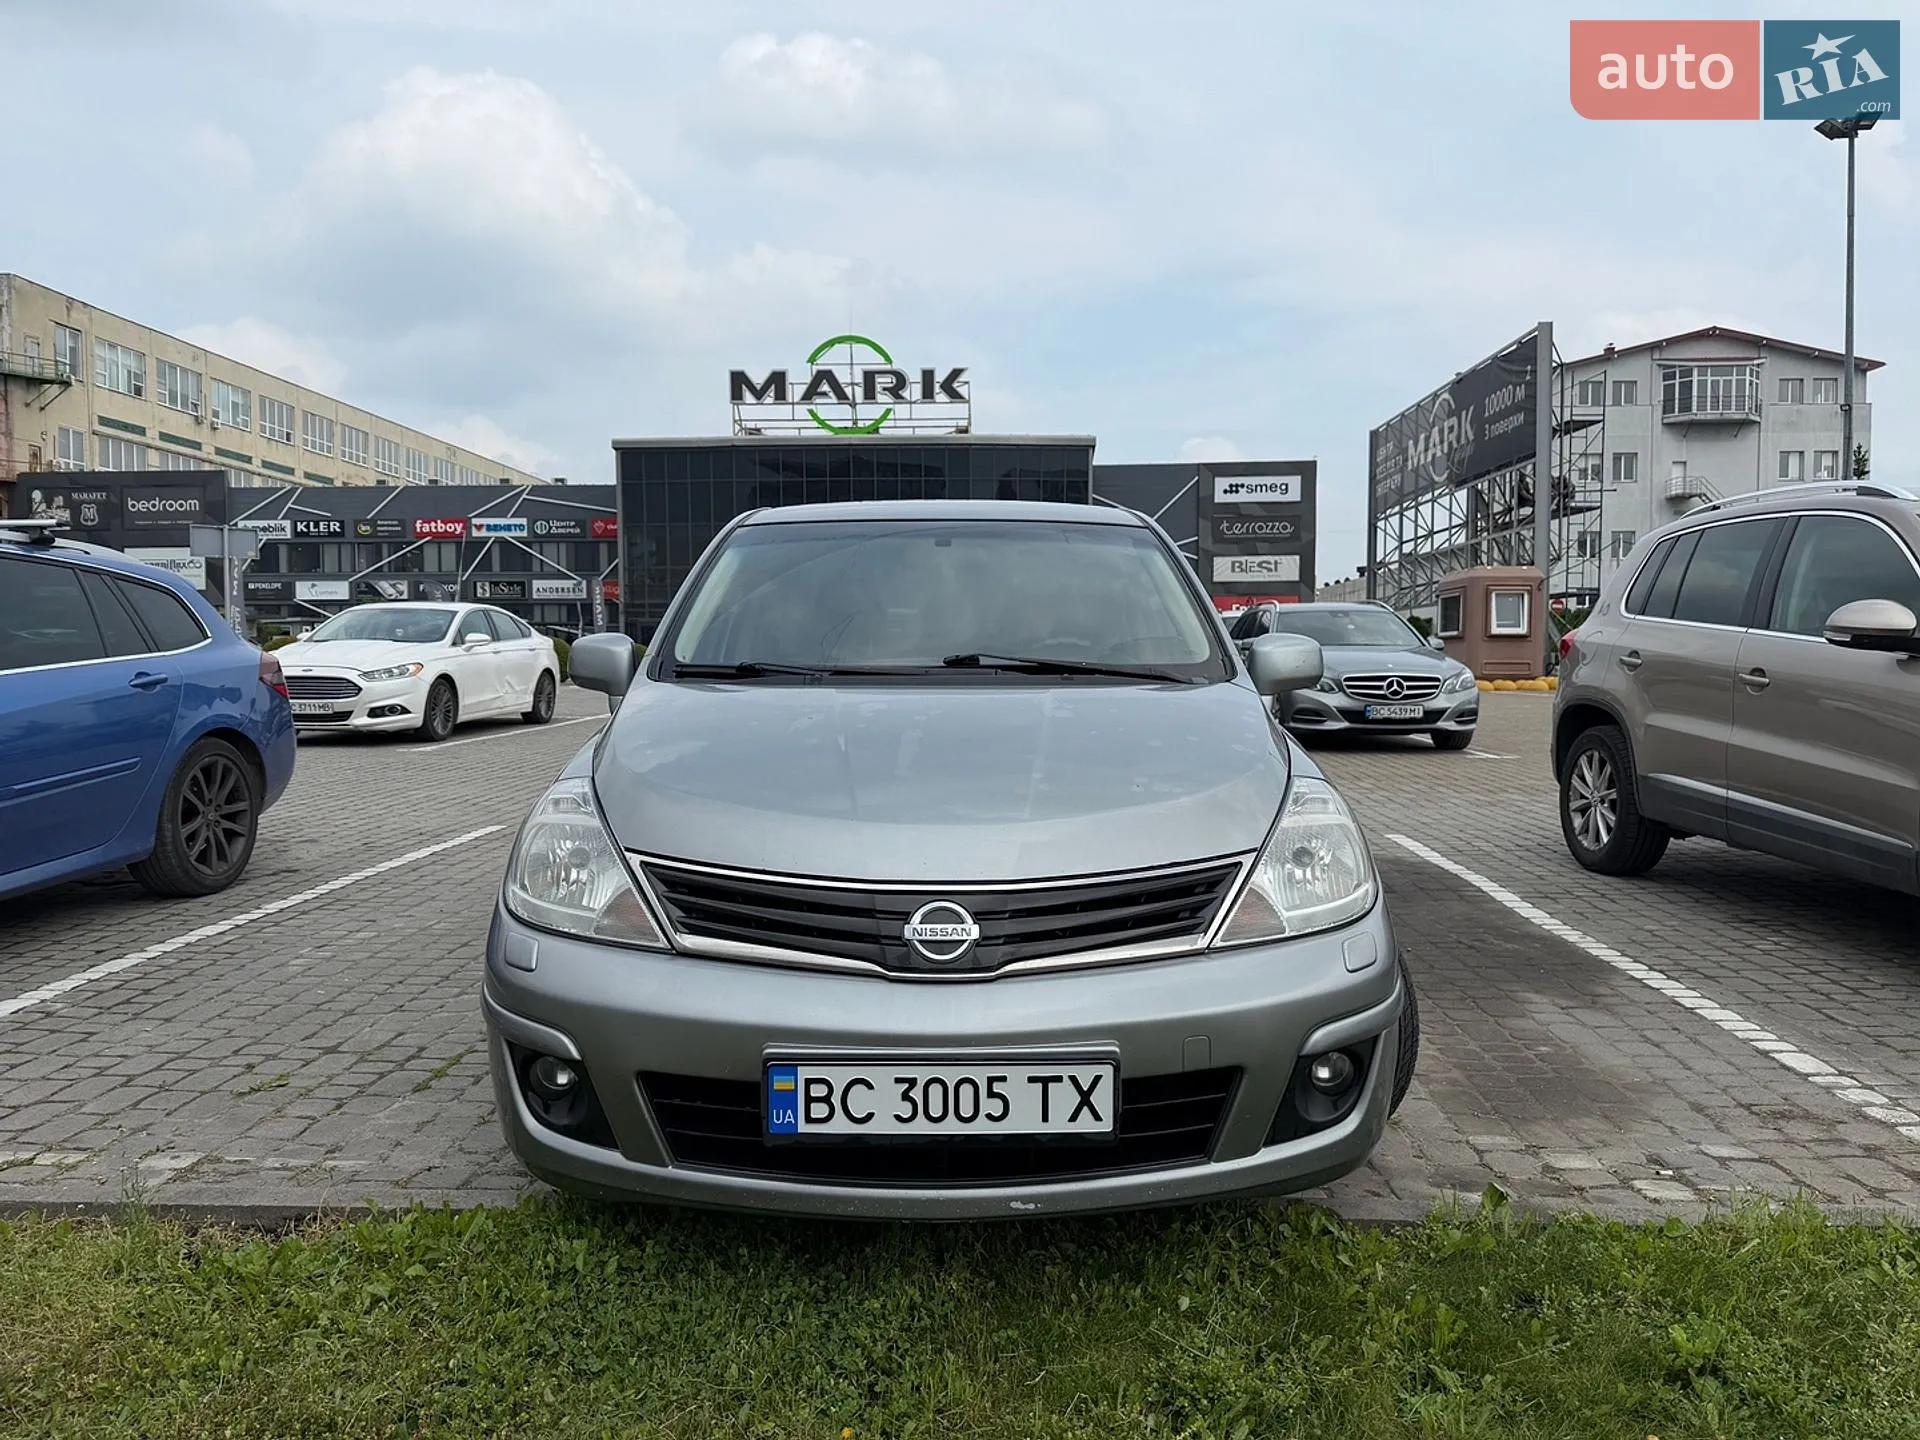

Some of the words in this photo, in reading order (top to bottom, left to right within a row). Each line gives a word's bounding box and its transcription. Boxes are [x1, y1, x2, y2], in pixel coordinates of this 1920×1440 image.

[729, 367, 968, 404] MARK
[1484, 384, 1513, 418] 10000
[1407, 405, 1475, 471] MARK
[1246, 482, 1289, 495] smeg
[128, 497, 199, 512] bedroom
[296, 521, 341, 532] KLER
[415, 520, 463, 534] fatboy
[535, 586, 584, 594] ANDERSEN
[912, 927, 972, 937] NISSAN
[803, 1075, 876, 1125] BC
[893, 1075, 1011, 1124] 3005
[1026, 1074, 1104, 1123] TX
[773, 1109, 795, 1124] UA
